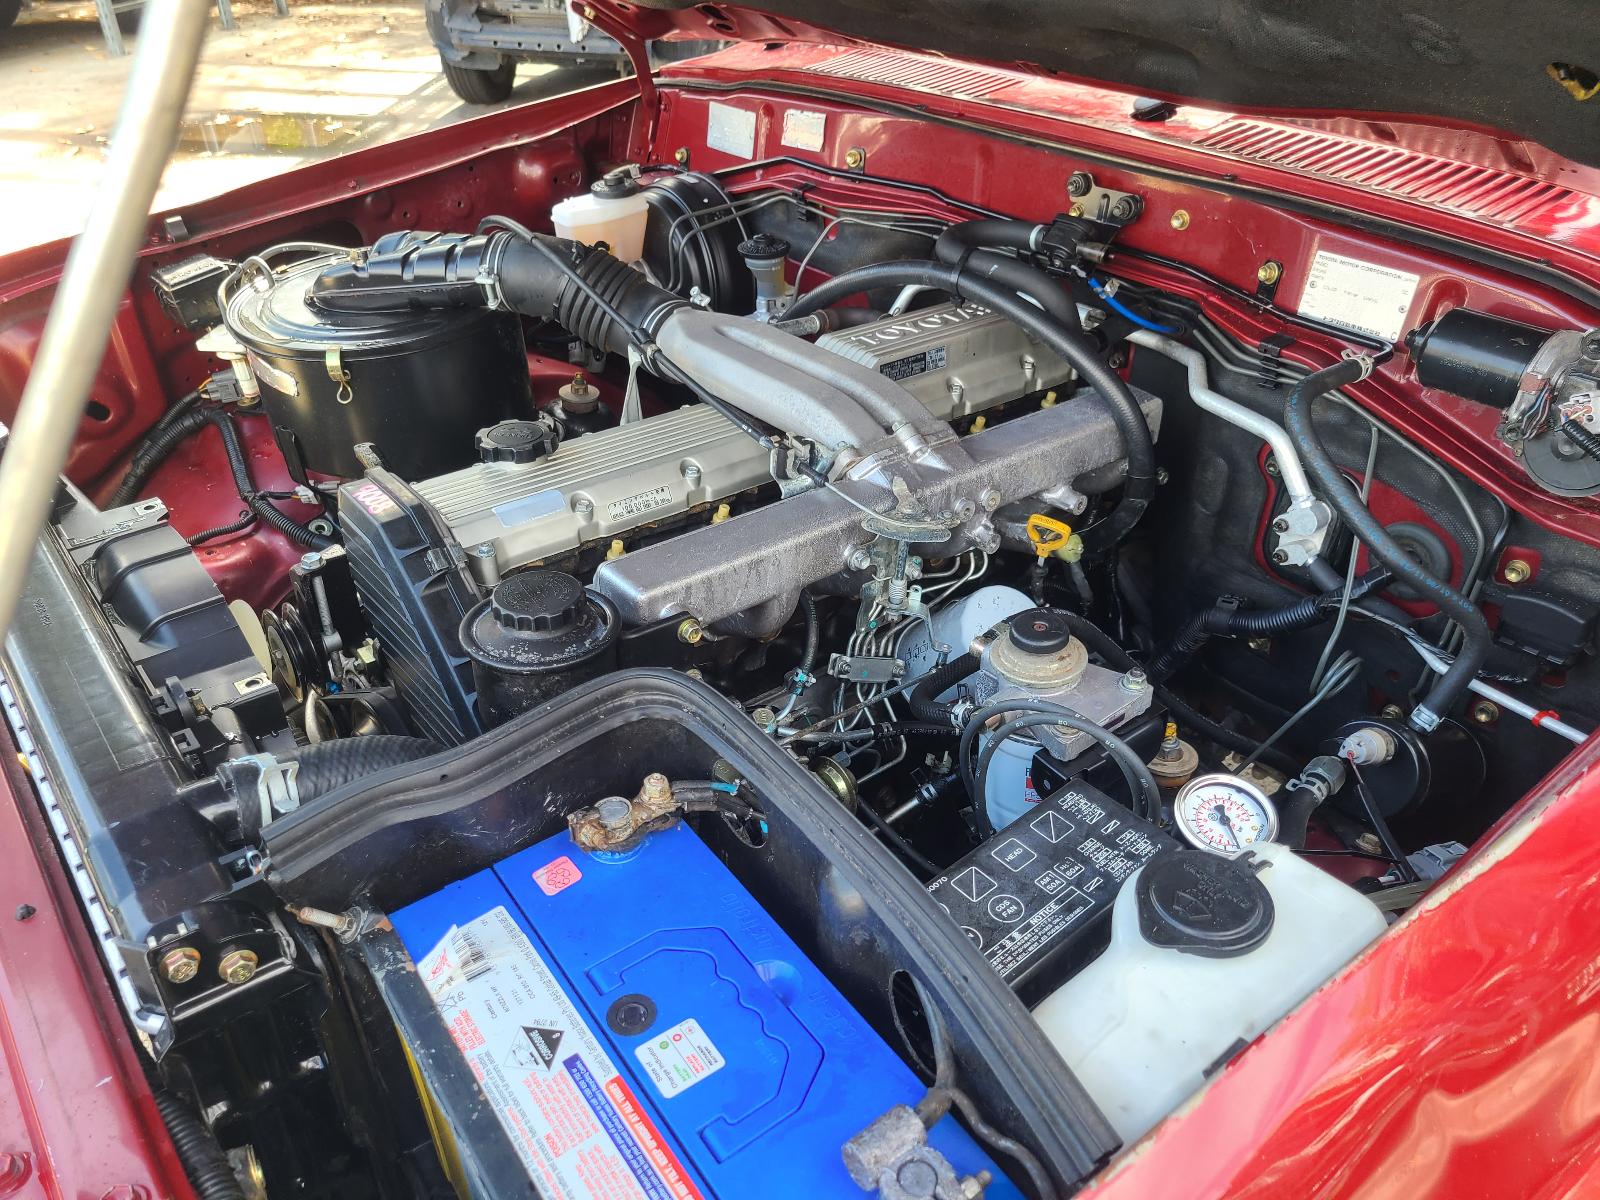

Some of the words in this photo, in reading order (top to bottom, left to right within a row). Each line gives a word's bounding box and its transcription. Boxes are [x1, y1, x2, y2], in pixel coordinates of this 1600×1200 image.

[1338, 259, 1359, 268] MOTOR
[1359, 265, 1402, 279] CORPORATION
[851, 306, 973, 345] TOYOTA
[1004, 846, 1023, 863] HEAD
[1083, 840, 1103, 857] CHARGE
[1139, 843, 1154, 856] DOME
[1065, 863, 1081, 877] 60A
[1039, 872, 1054, 886] AM1
[1046, 877, 1062, 891] 50A
[994, 898, 1010, 912] CDS
[1002, 904, 1018, 918] FAN
[1029, 901, 1059, 925] NOTICE
[1037, 922, 1053, 936] FUSES
[455, 989, 466, 1001] Pb
[551, 1031, 561, 1039] 8
[528, 1028, 554, 1061] CORROSIVE
[646, 1044, 665, 1070] Indicator
[696, 1043, 713, 1067] RECHARGE
[703, 1044, 718, 1064] BATTERY
[645, 1060, 653, 1068] of
[649, 1066, 663, 1083] State
[661, 1067, 679, 1089] Charge
[608, 1081, 626, 1103] TIMES
[620, 1099, 634, 1114] ALL
[627, 1111, 640, 1123] AT
[633, 1120, 657, 1149] UPRIGHT
[651, 1146, 669, 1167] KEEP
